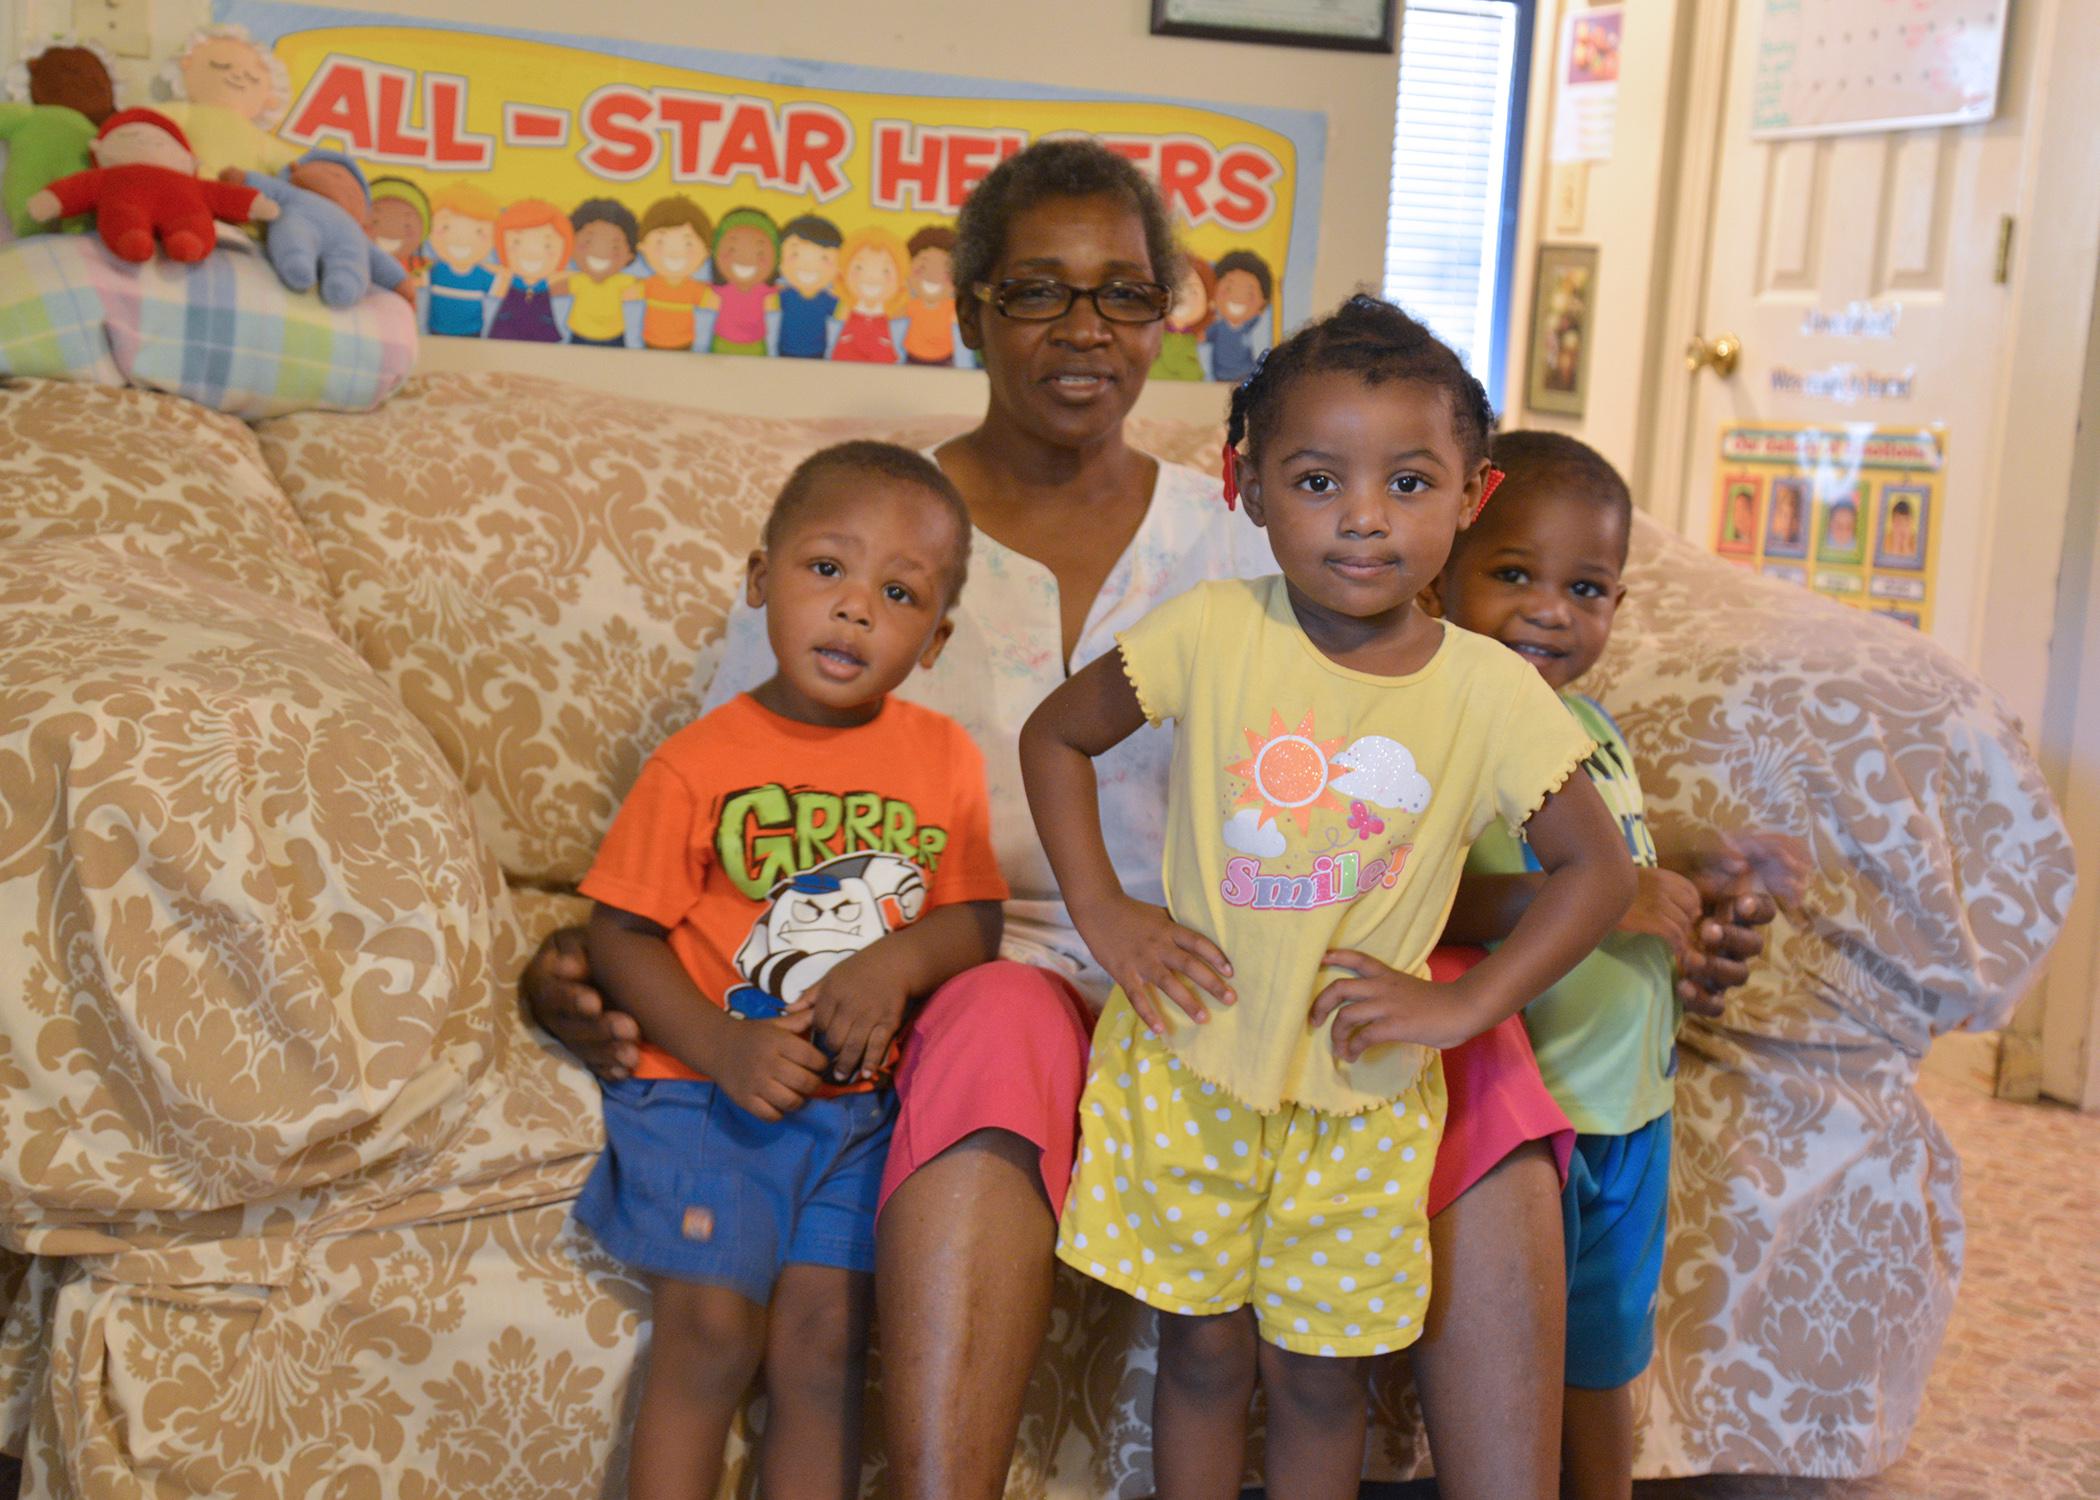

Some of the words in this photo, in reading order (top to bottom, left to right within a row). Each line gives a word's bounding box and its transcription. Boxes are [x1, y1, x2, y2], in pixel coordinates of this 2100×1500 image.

[281, 55, 492, 169] ALL
[579, 85, 852, 201] STAR
[875, 120, 1281, 230] HERS
[714, 783, 948, 900] GRRRR
[1220, 844, 1414, 911] Smile!
